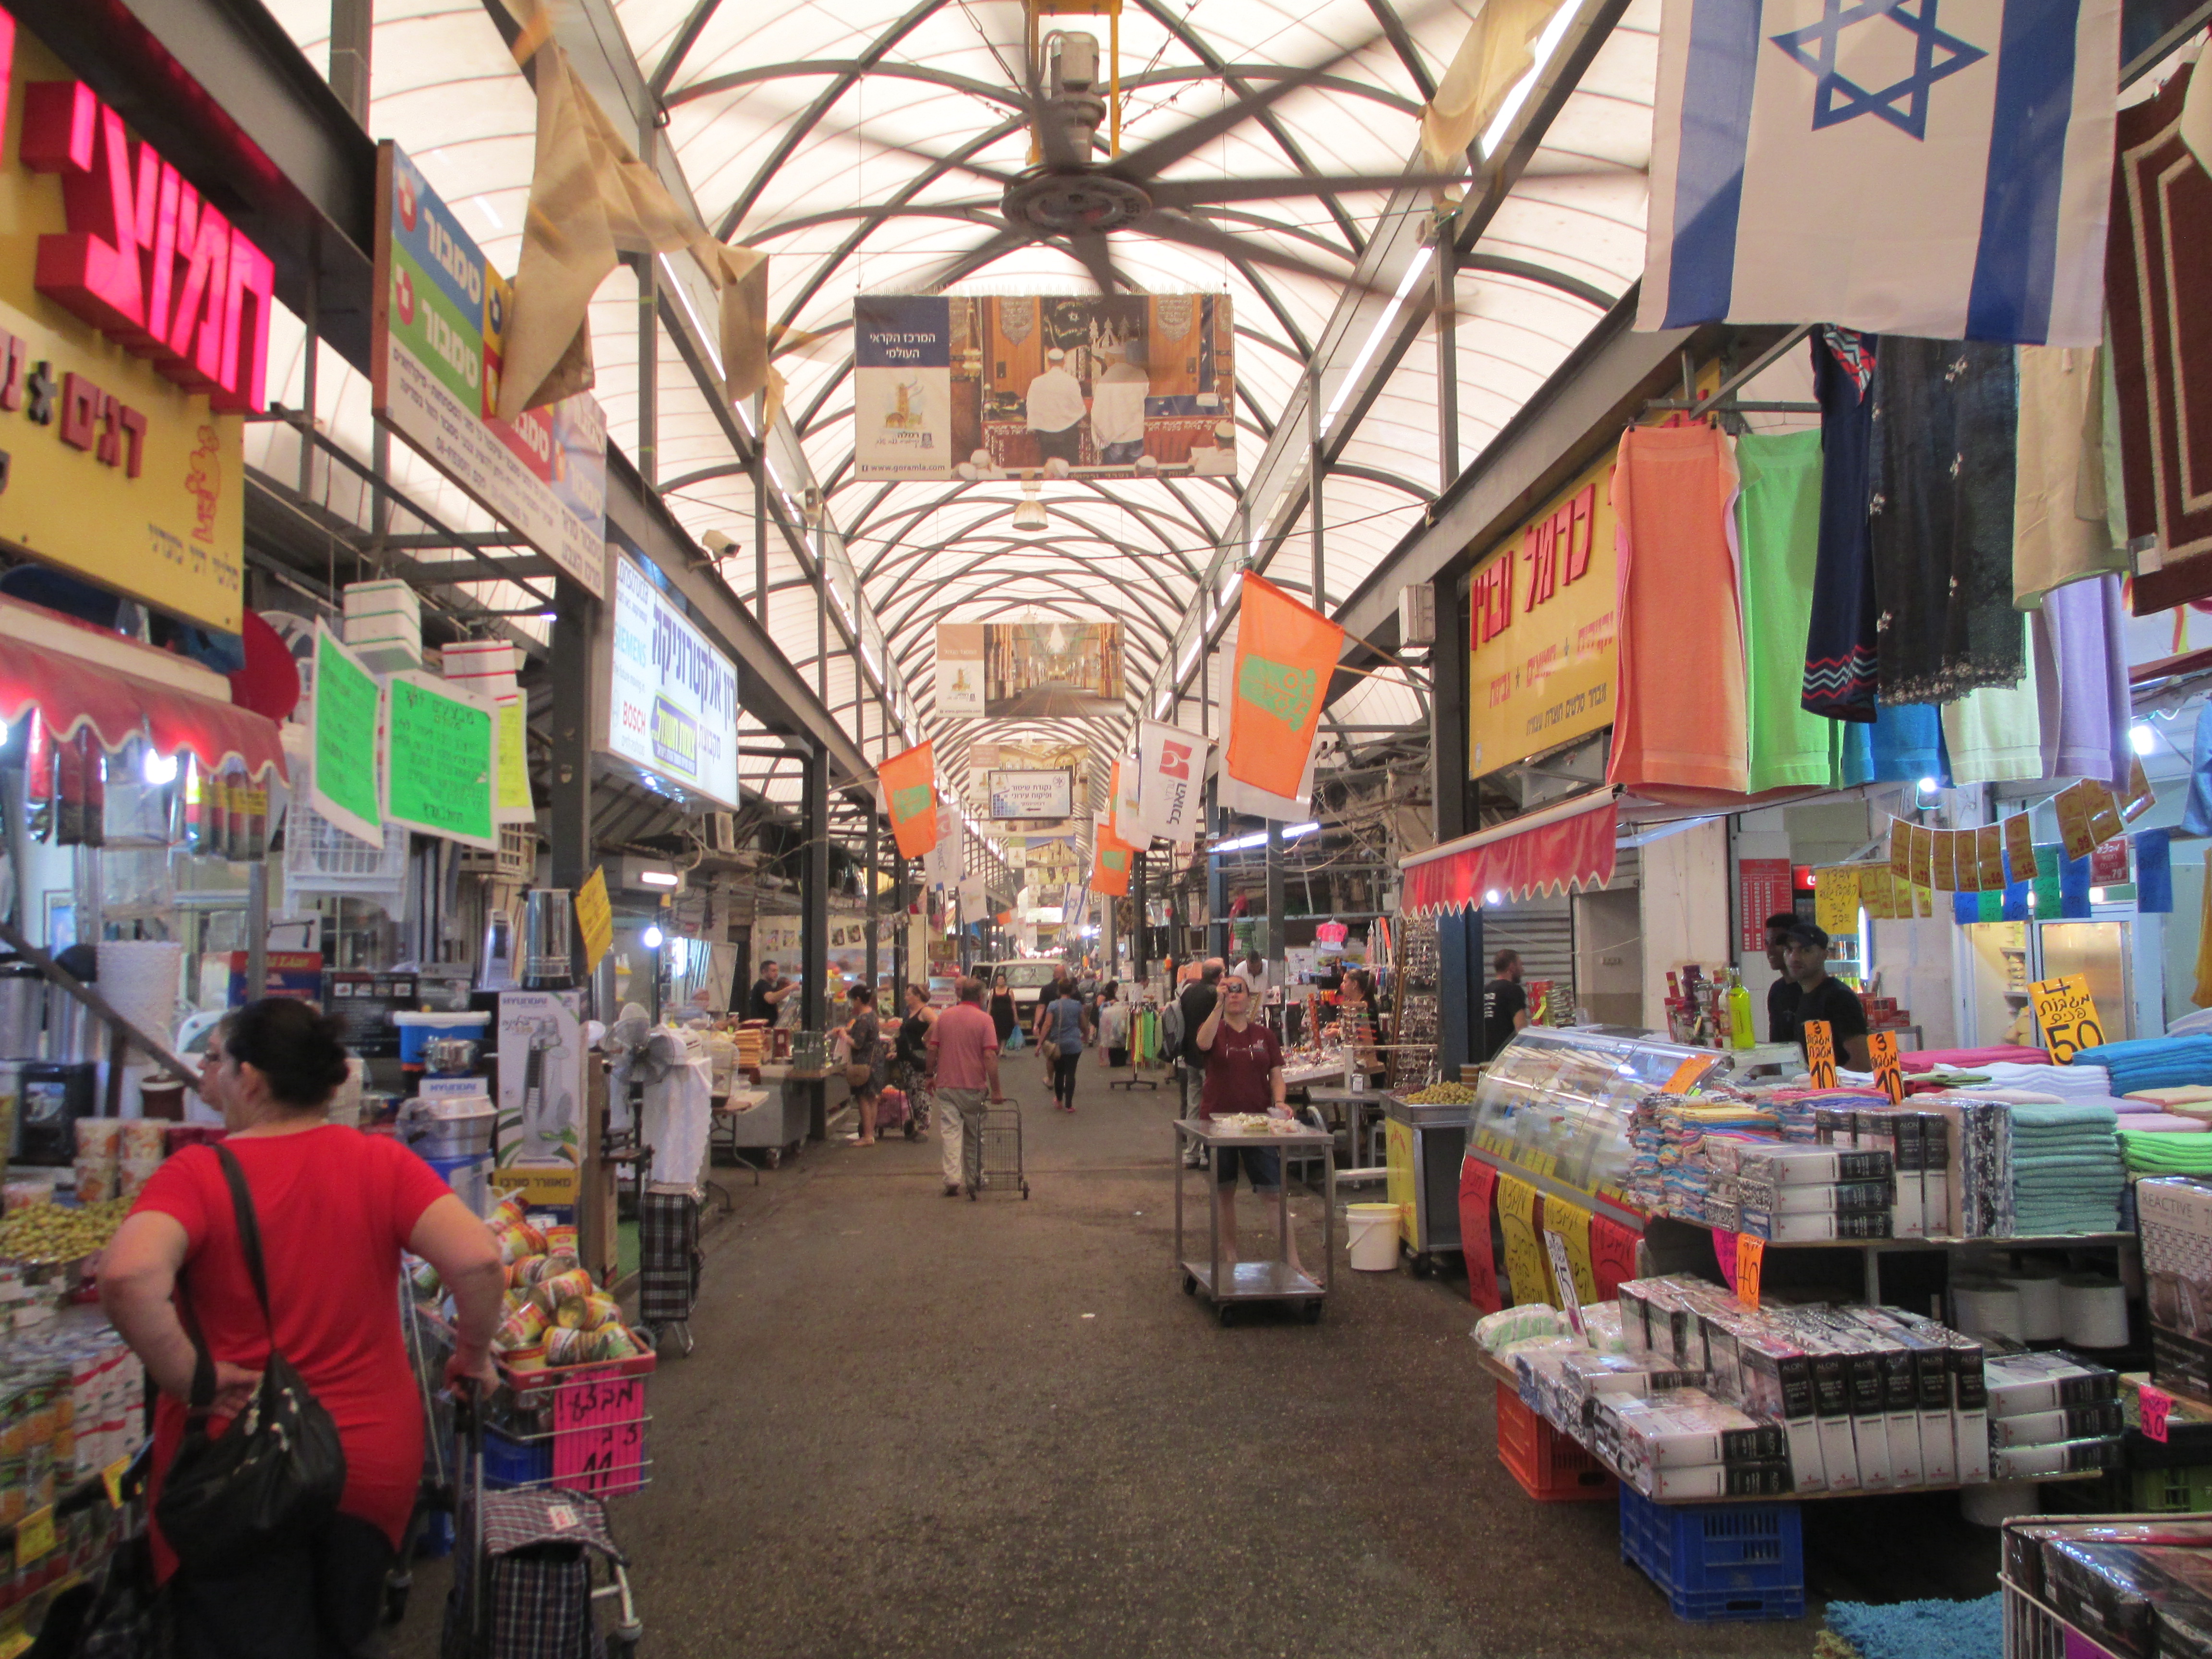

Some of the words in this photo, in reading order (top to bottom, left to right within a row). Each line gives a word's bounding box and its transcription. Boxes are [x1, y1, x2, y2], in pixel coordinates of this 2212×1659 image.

[0, 6, 275, 415] חמוצי
[422, 206, 481, 305] טמבור
[421, 297, 479, 389] טמבור
[870, 333, 901, 345] הקראי
[904, 333, 936, 343] המרכז
[886, 346, 920, 358] העולמי
[60, 372, 147, 479] דגים
[871, 463, 945, 472] www.goramla.com
[1524, 483, 1595, 614] כרמל
[614, 623, 646, 668] SIEMENS
[652, 603, 721, 714] אלקטרוניקה
[622, 701, 646, 736] BOSCH
[1166, 782, 1187, 825] האוכל
[2041, 977, 2071, 997] 4
[2039, 993, 2090, 1017] מגבות
[2050, 1008, 2086, 1025] פנים
[1813, 1021, 1821, 1034] 3
[1875, 1033, 1887, 1051] 3
[2045, 1020, 2104, 1065] 50
[1810, 1060, 1835, 1089] 10
[1876, 1068, 1904, 1105] 10
[430, 1083, 477, 1092] HYUNDAI
[2142, 1191, 2192, 1218] REACTIVE
[1738, 1254, 1758, 1295] 40
[1782, 1362, 1804, 1371] ALON
[1816, 1361, 1839, 1371] ALON
[1853, 1360, 1875, 1369] ALON
[1922, 1355, 1943, 1363] ALON
